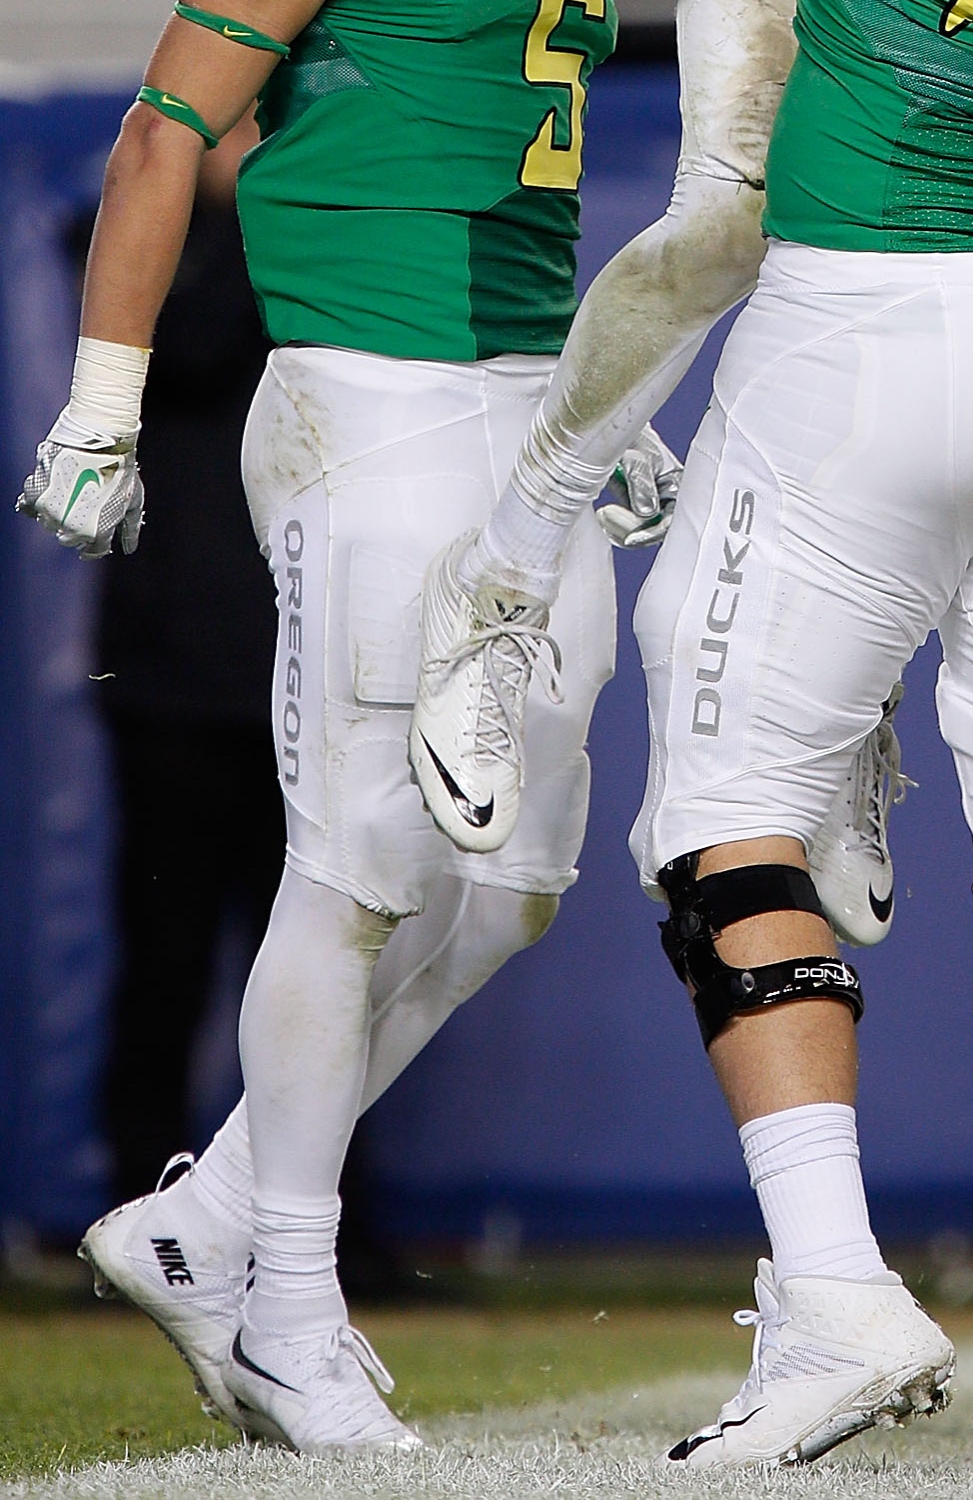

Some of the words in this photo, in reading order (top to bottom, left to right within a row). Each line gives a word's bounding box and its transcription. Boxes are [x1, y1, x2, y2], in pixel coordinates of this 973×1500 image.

[283, 518, 305, 787] OREGON
[690, 488, 755, 738] DUCKS
[150, 1238, 195, 1286] NIKE
